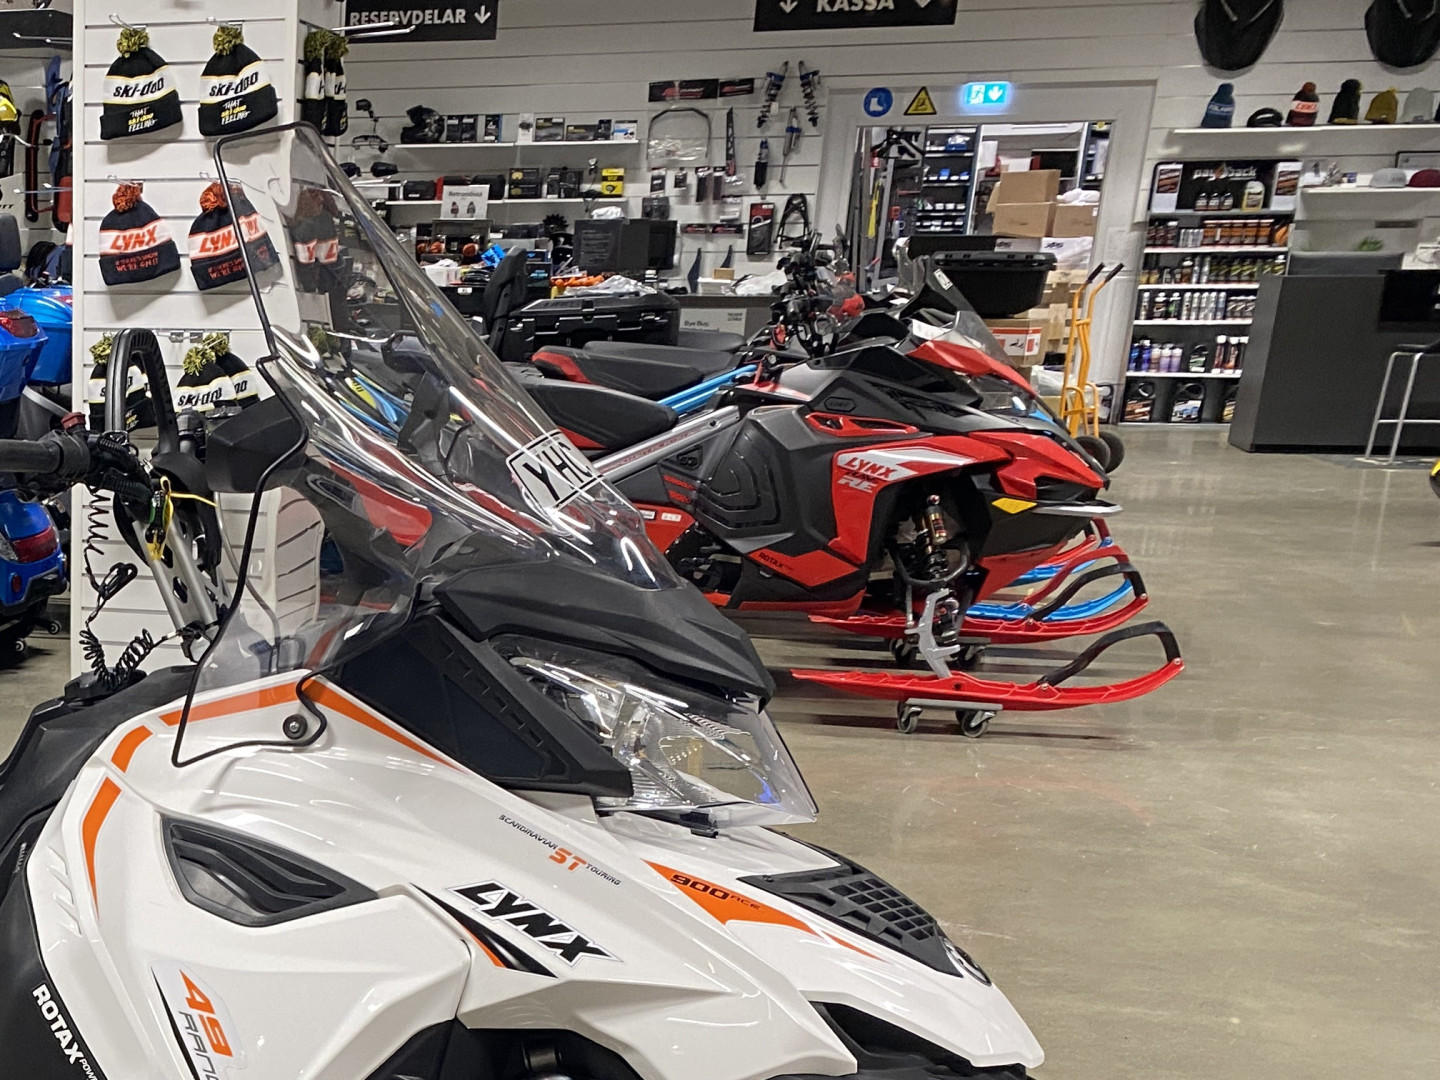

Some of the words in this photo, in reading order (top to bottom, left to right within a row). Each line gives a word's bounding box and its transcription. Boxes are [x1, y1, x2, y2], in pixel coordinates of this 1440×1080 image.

[349, 8, 467, 26] RESERVDELAR
[816, 0, 895, 13] KASSA
[110, 225, 158, 250] LYNX
[843, 456, 897, 479] LYNX
[837, 476, 878, 494] RE
[498, 814, 560, 850] SCANDINAVIAN
[548, 847, 587, 871] ST
[585, 862, 622, 886] TOURING
[670, 873, 728, 900] 900
[453, 881, 613, 964] LYNX
[32, 983, 83, 1065] ROTAX
[179, 968, 234, 1058] 49
